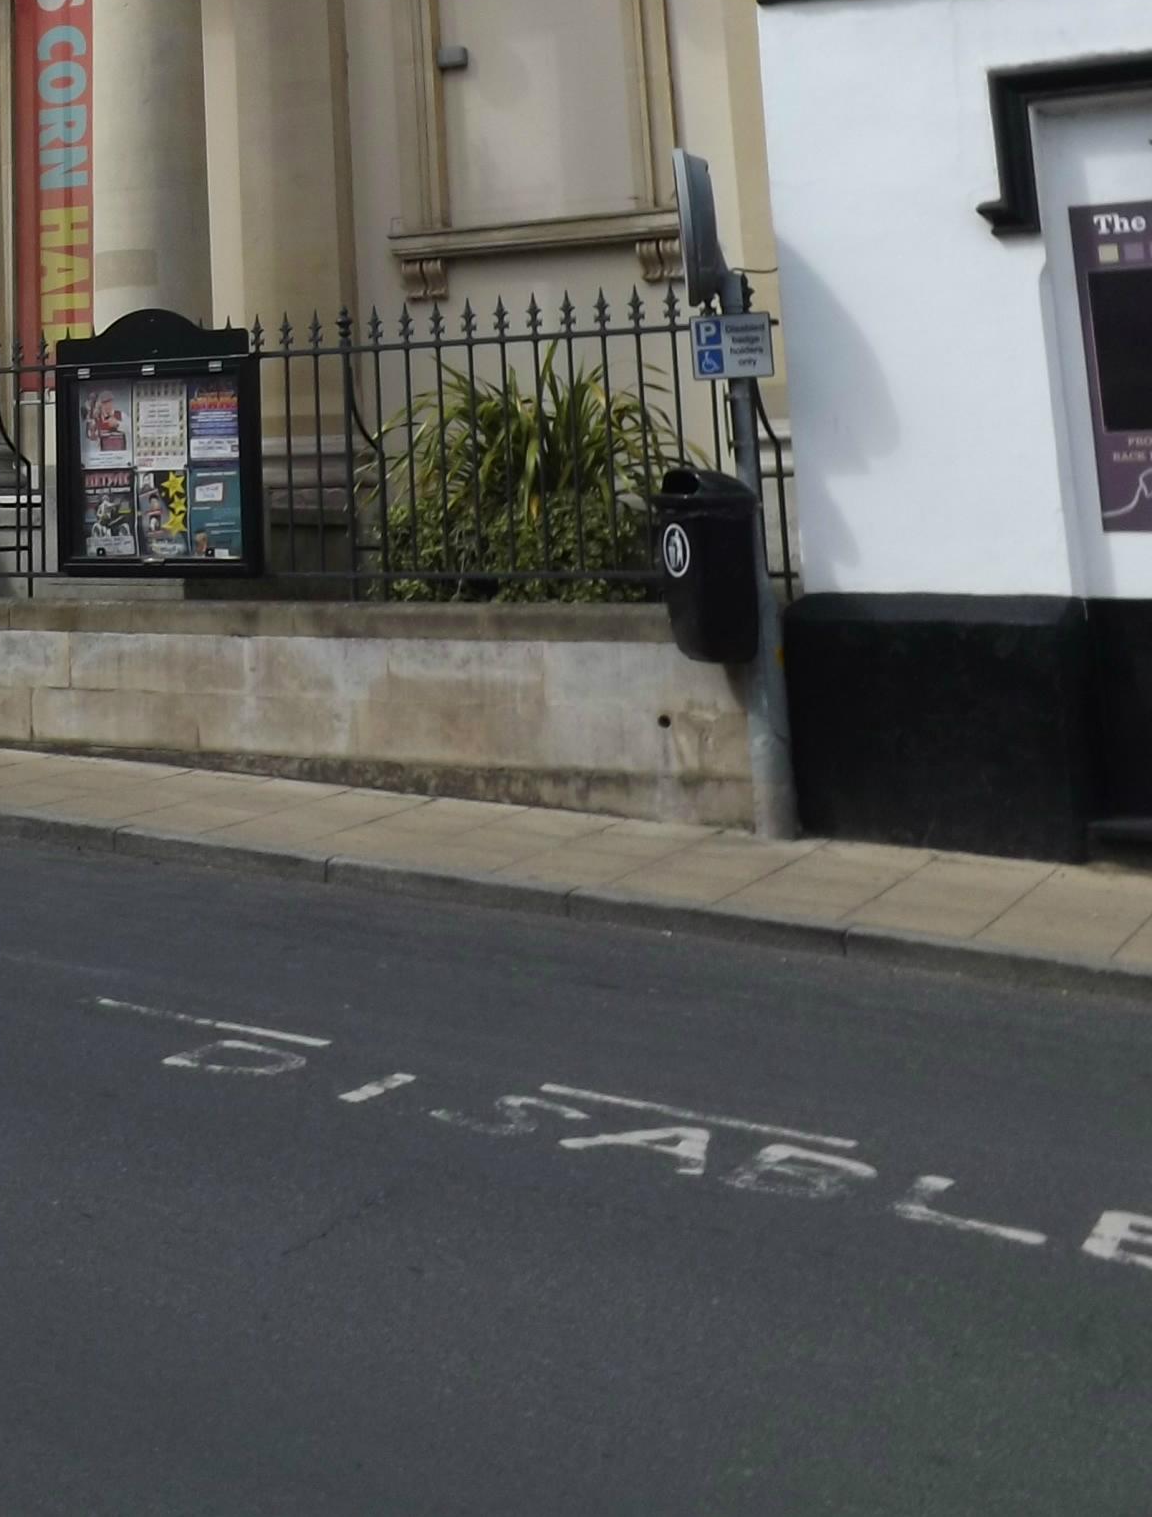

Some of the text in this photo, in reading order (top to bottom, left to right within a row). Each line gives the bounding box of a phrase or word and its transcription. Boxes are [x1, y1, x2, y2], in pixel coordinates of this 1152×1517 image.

[37, 25, 89, 190] CORN
[1093, 213, 1146, 234] The
[699, 322, 716, 344] P
